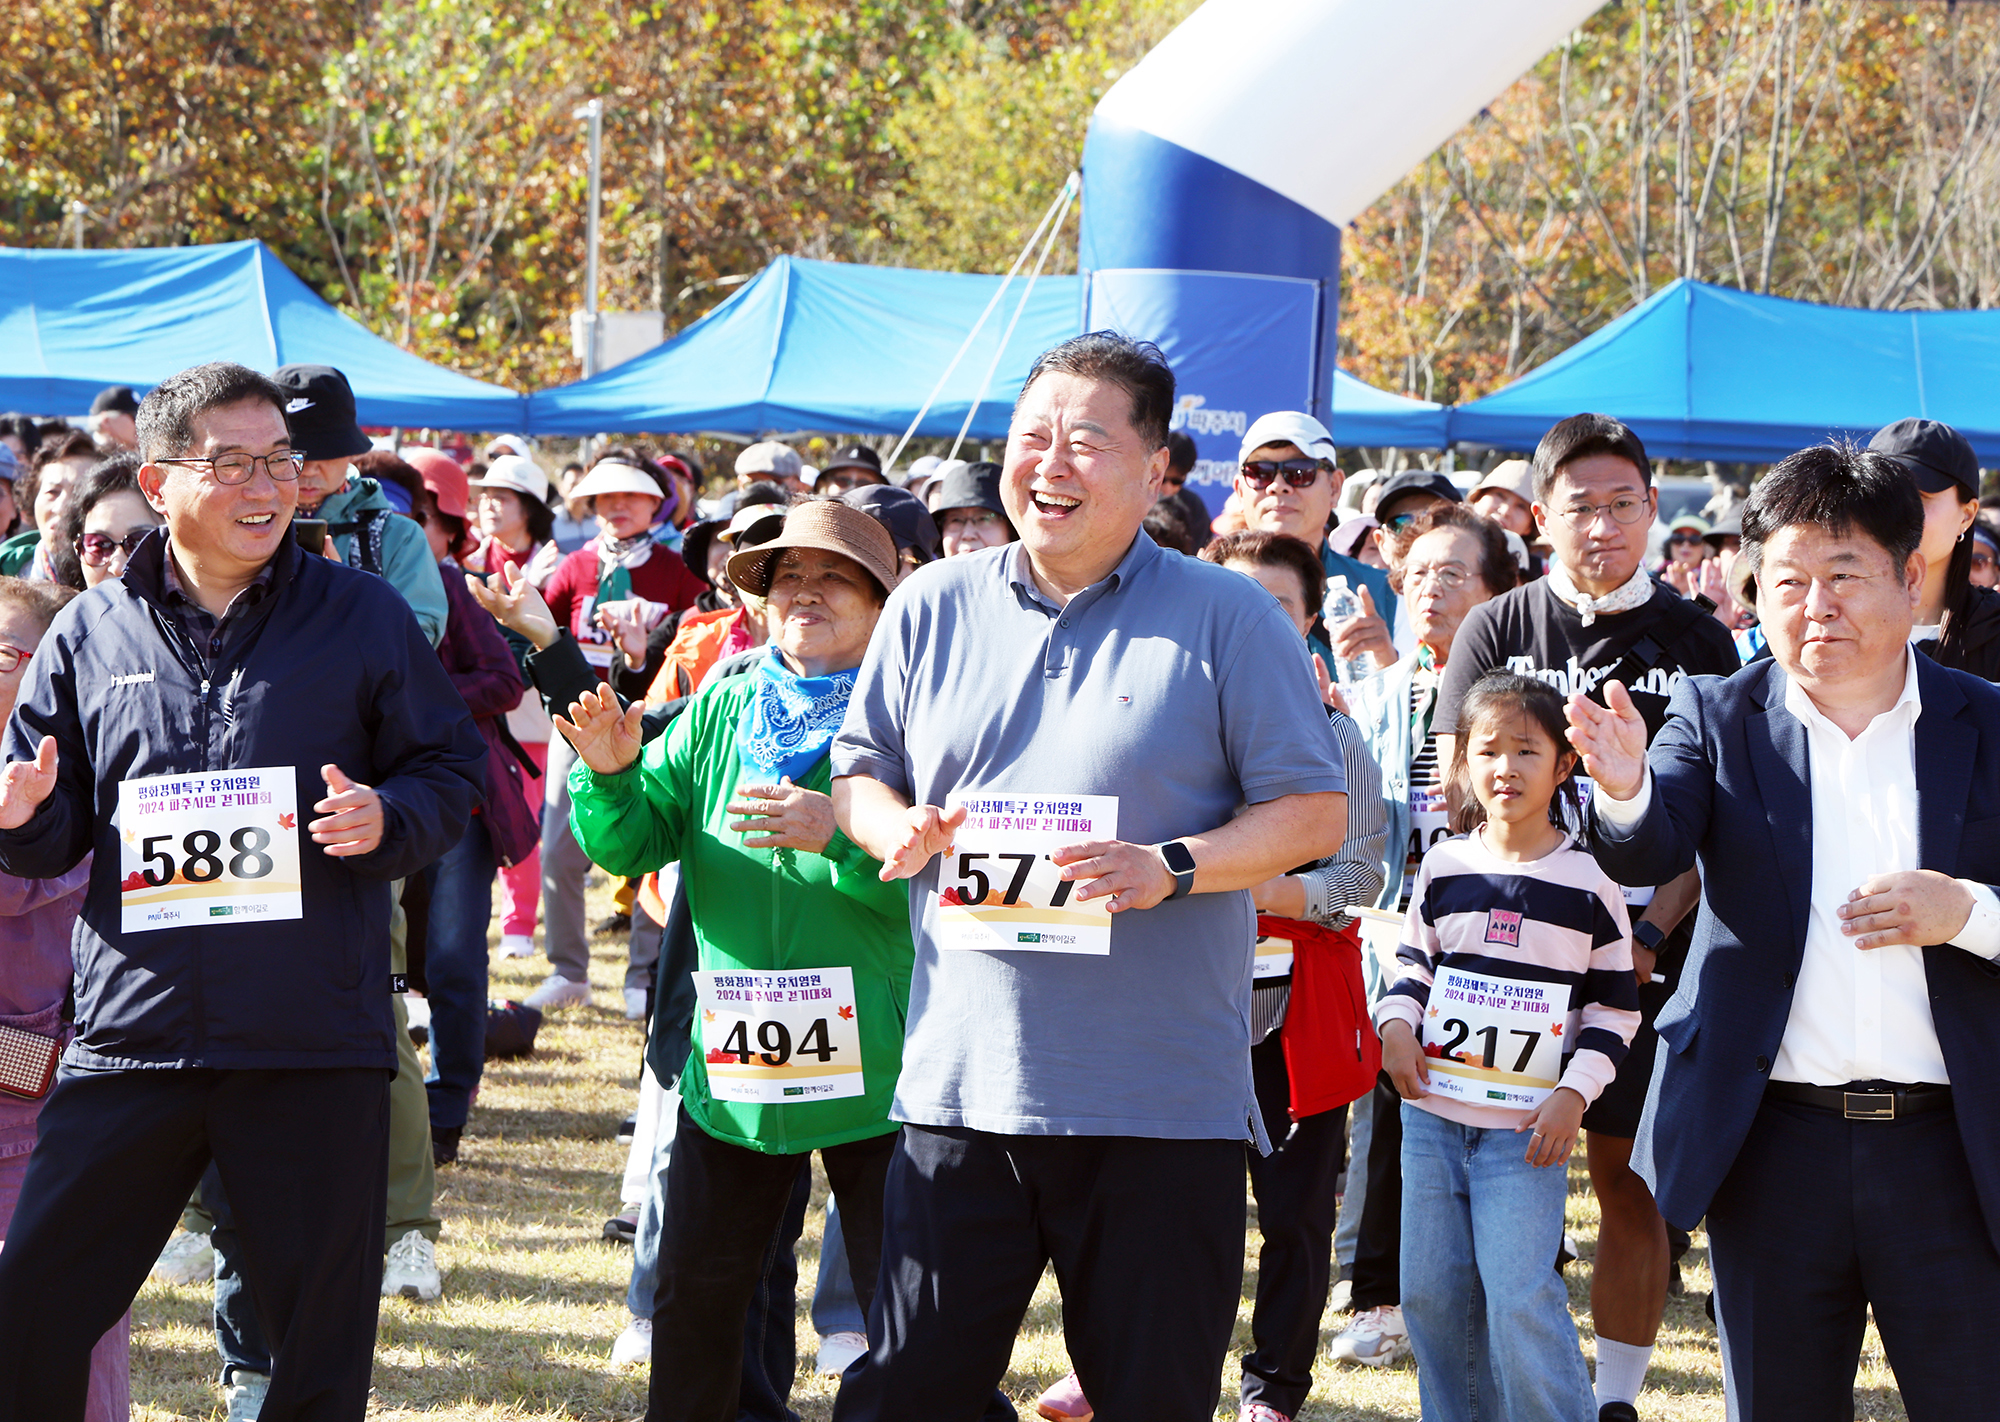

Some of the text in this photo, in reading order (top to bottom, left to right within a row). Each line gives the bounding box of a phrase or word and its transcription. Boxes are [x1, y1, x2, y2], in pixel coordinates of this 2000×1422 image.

[138, 776, 261, 799] 평화경제특구 유치염원
[139, 791, 272, 815] 2024 파주시민 걷기대회
[1033, 801, 1083, 816] 유치염원
[989, 817, 1037, 831] 파주시민
[1042, 818, 1092, 832] 걷기대회
[143, 826, 274, 886] 588
[1492, 922, 1516, 932] AND
[1494, 911, 1519, 923] YOU
[714, 975, 821, 988] 평화경제특구 유치염원
[1448, 975, 1544, 1000] 평화경제특구 유치염원
[716, 988, 832, 1002] 2024 파주시민 걷기대회
[1444, 988, 1550, 1014] 2024 파주시민 걷기대회
[722, 1018, 838, 1066] 494
[1441, 1018, 1541, 1072] 217
